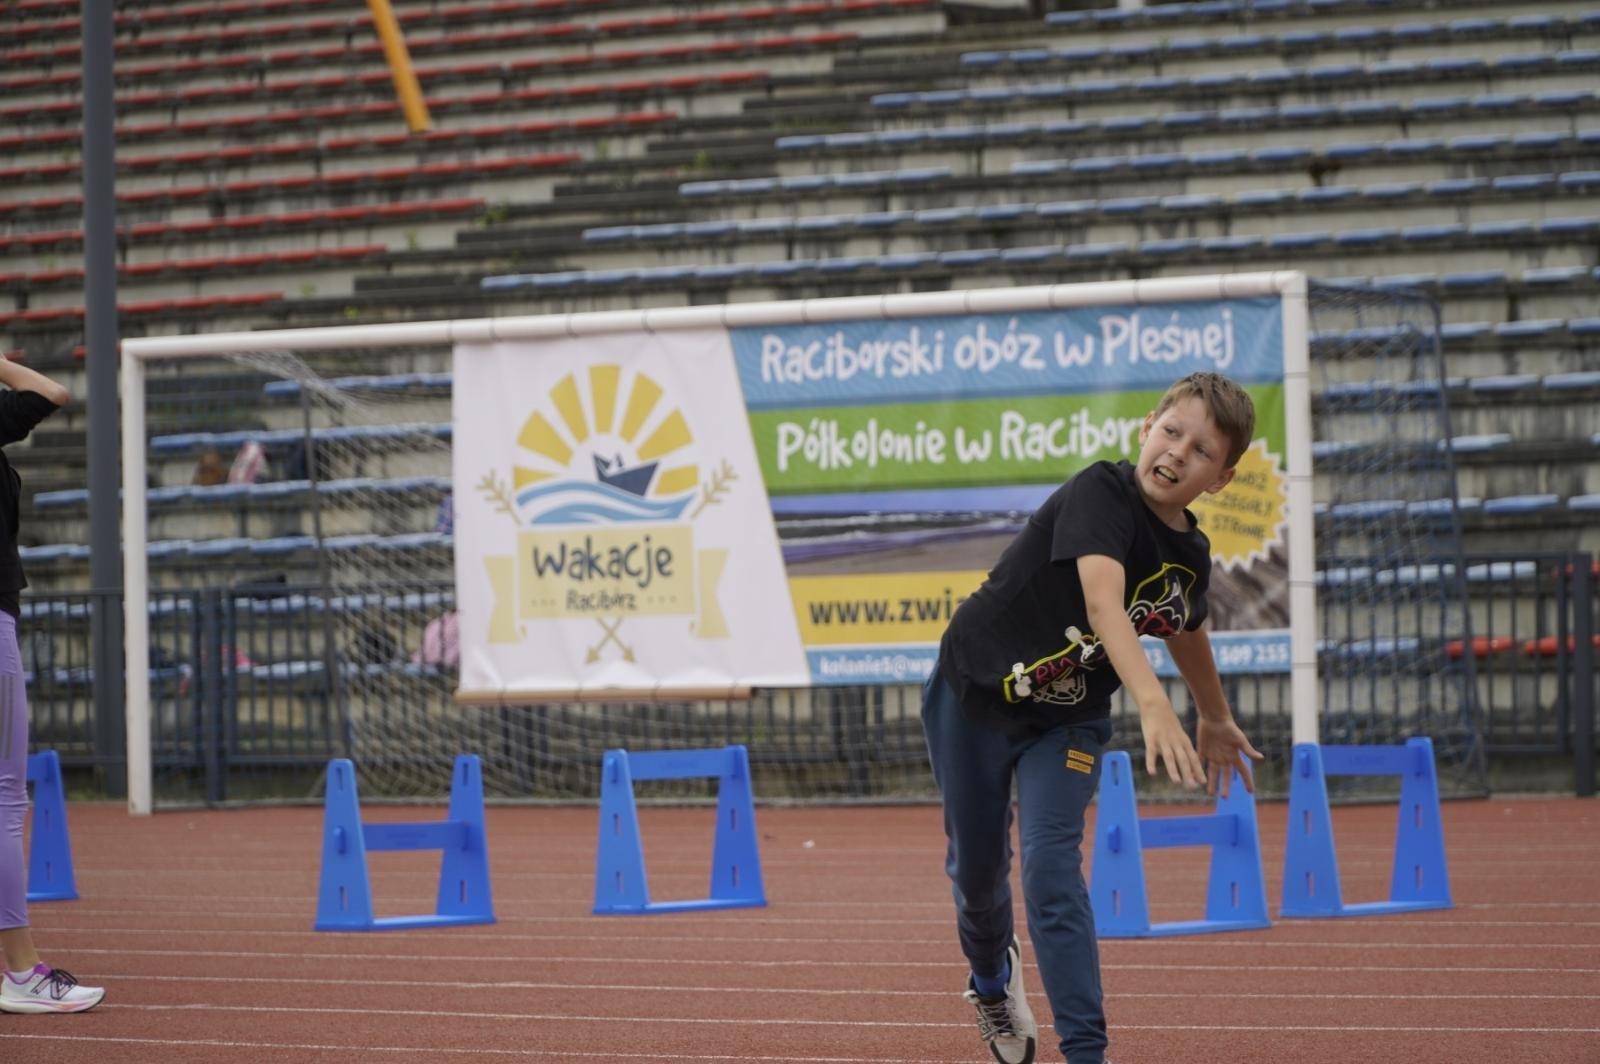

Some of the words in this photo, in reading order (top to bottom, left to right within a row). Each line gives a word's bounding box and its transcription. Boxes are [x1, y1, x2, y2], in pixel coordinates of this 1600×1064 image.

[761, 325, 945, 384] Raciborski
[953, 316, 1046, 373] obóz
[1054, 329, 1095, 369] w
[1099, 307, 1235, 370] Pleśnej
[776, 417, 947, 473] Półkolonie
[954, 426, 993, 463] w
[1000, 407, 1144, 462] Racibor
[810, 588, 968, 625] www.zwi
